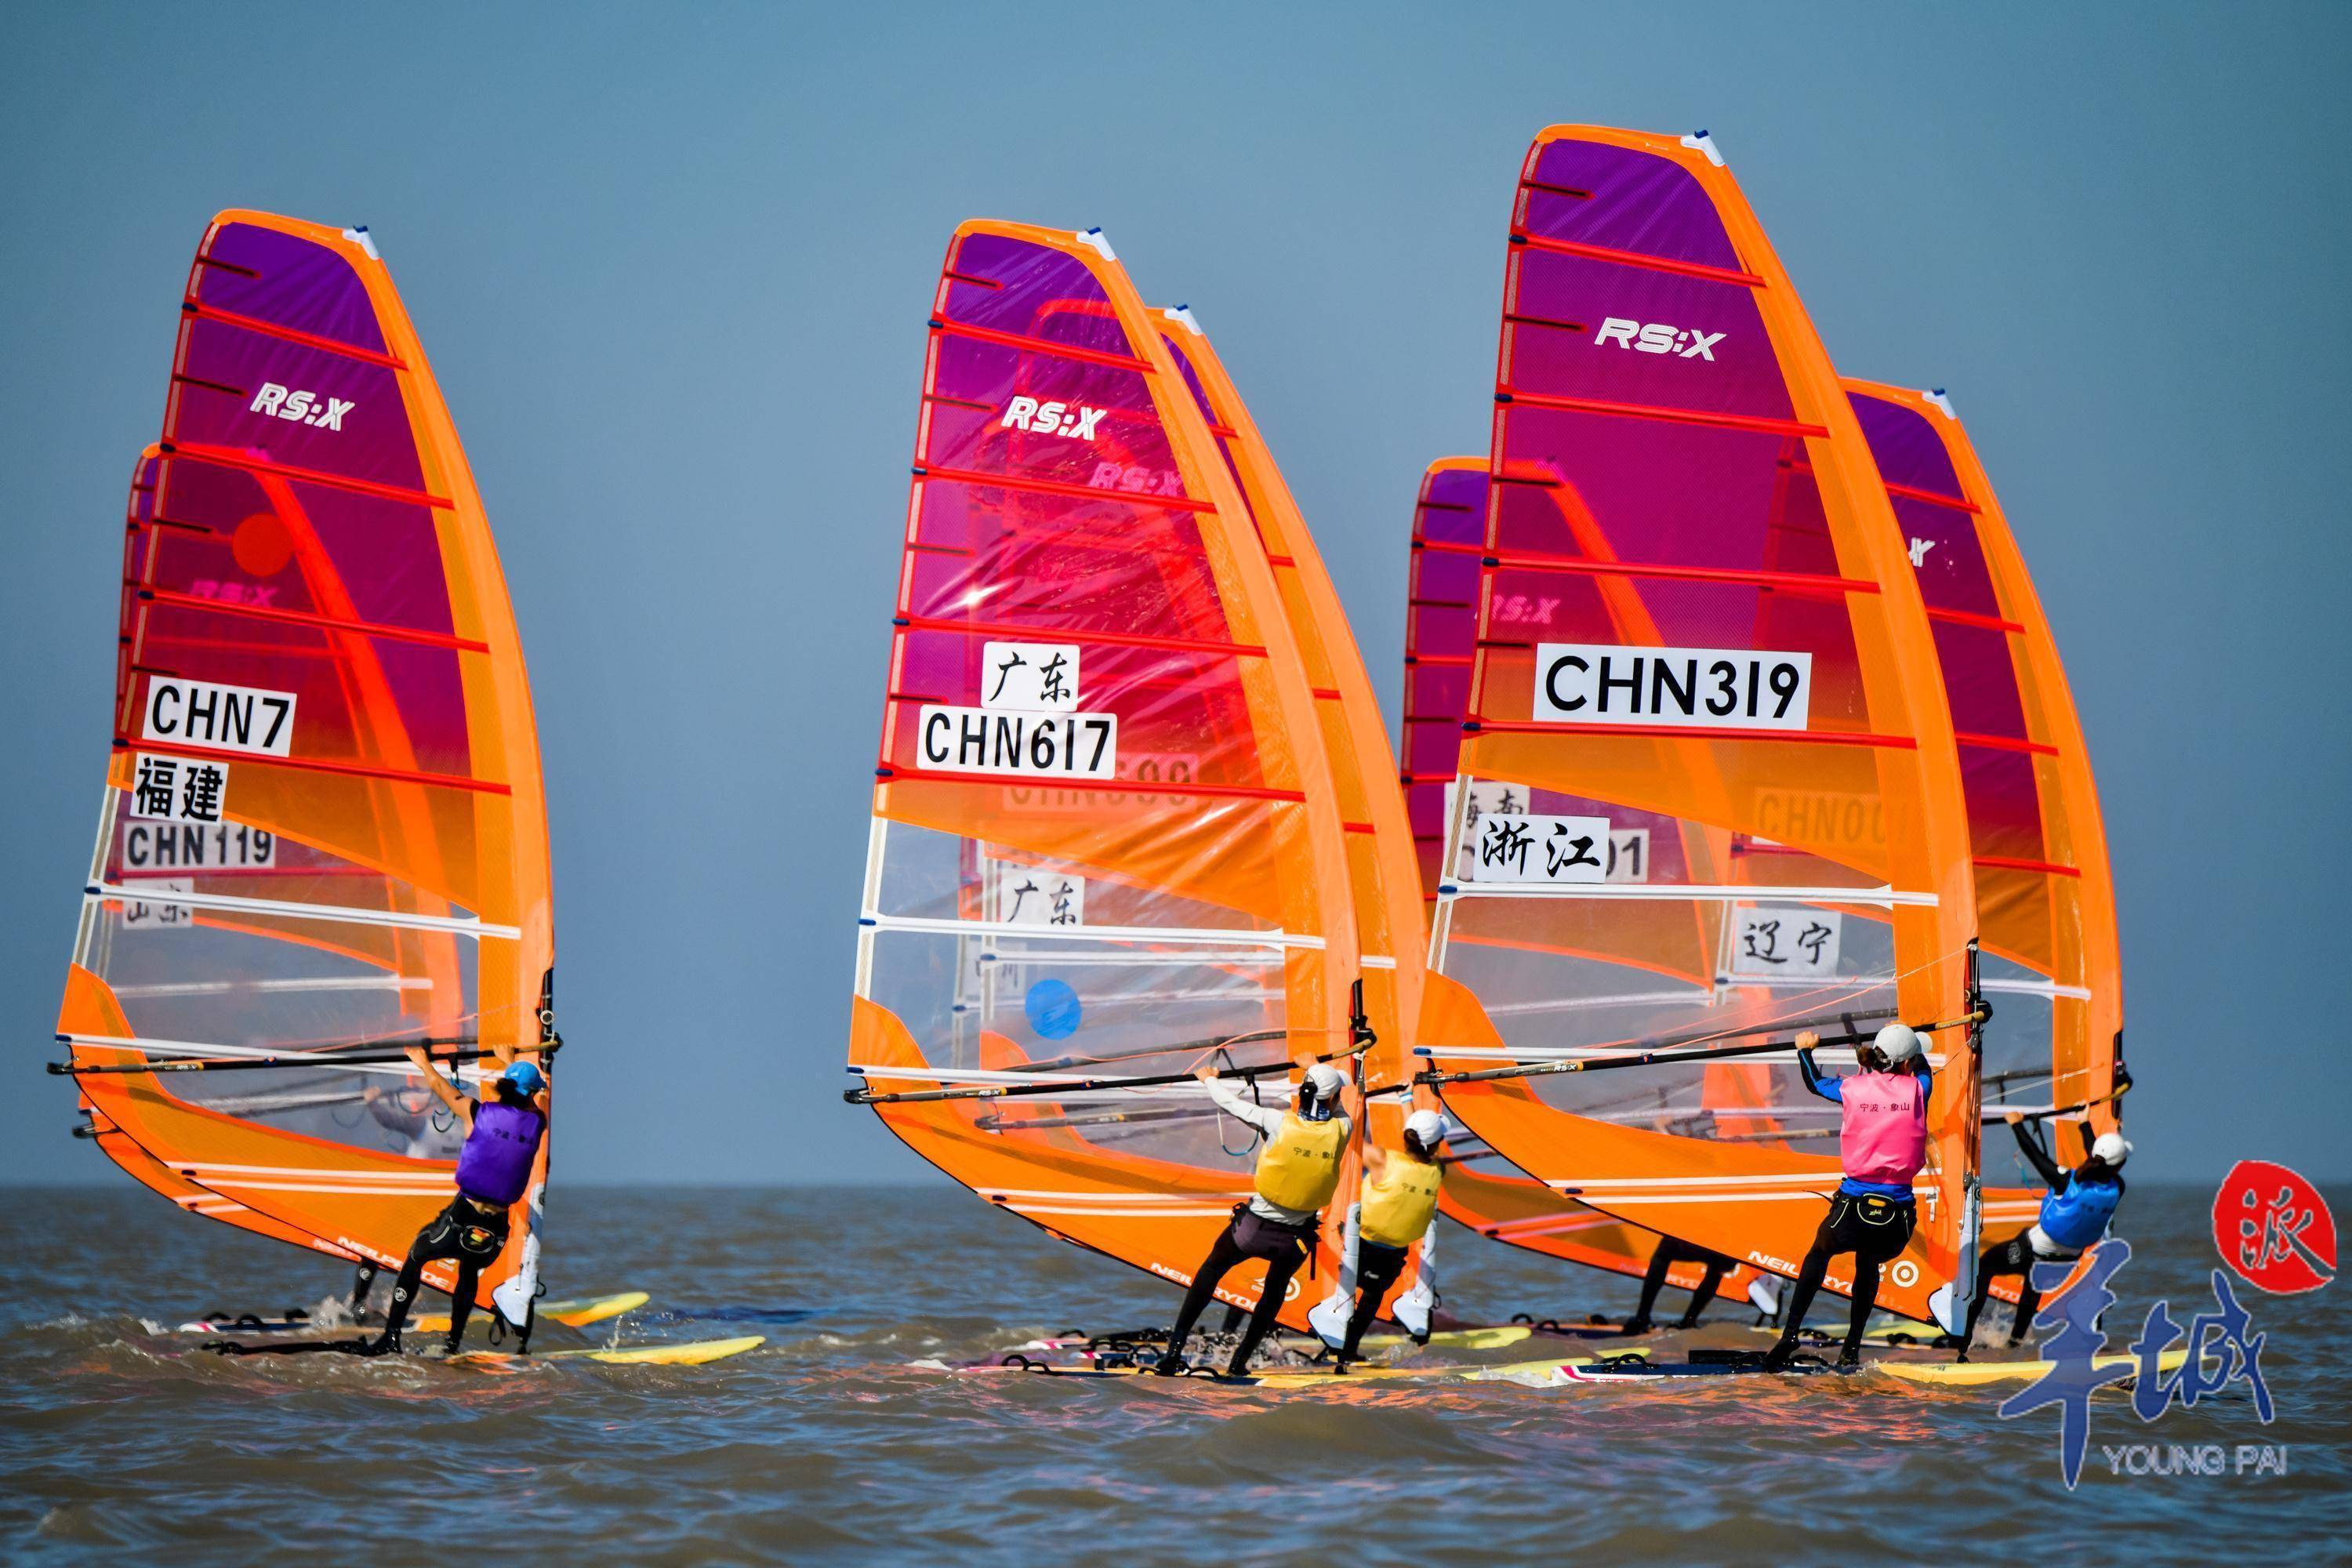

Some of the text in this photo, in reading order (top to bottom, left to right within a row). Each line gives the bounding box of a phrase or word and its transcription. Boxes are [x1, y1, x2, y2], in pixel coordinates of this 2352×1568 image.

[1595, 317, 1727, 362] RS:X
[250, 381, 355, 431] RS:X
[1000, 395, 1108, 441] RS:X
[989, 652, 1071, 703] 广东
[1545, 655, 1800, 719] CHN319
[152, 684, 290, 749] CHN7
[925, 713, 1110, 772] CHN617
[136, 757, 223, 822] 福建
[128, 826, 272, 866] CHN119
[1483, 820, 1601, 878] 浙江
[1007, 878, 1076, 925] 广东
[1744, 920, 1832, 965] 辽宁
